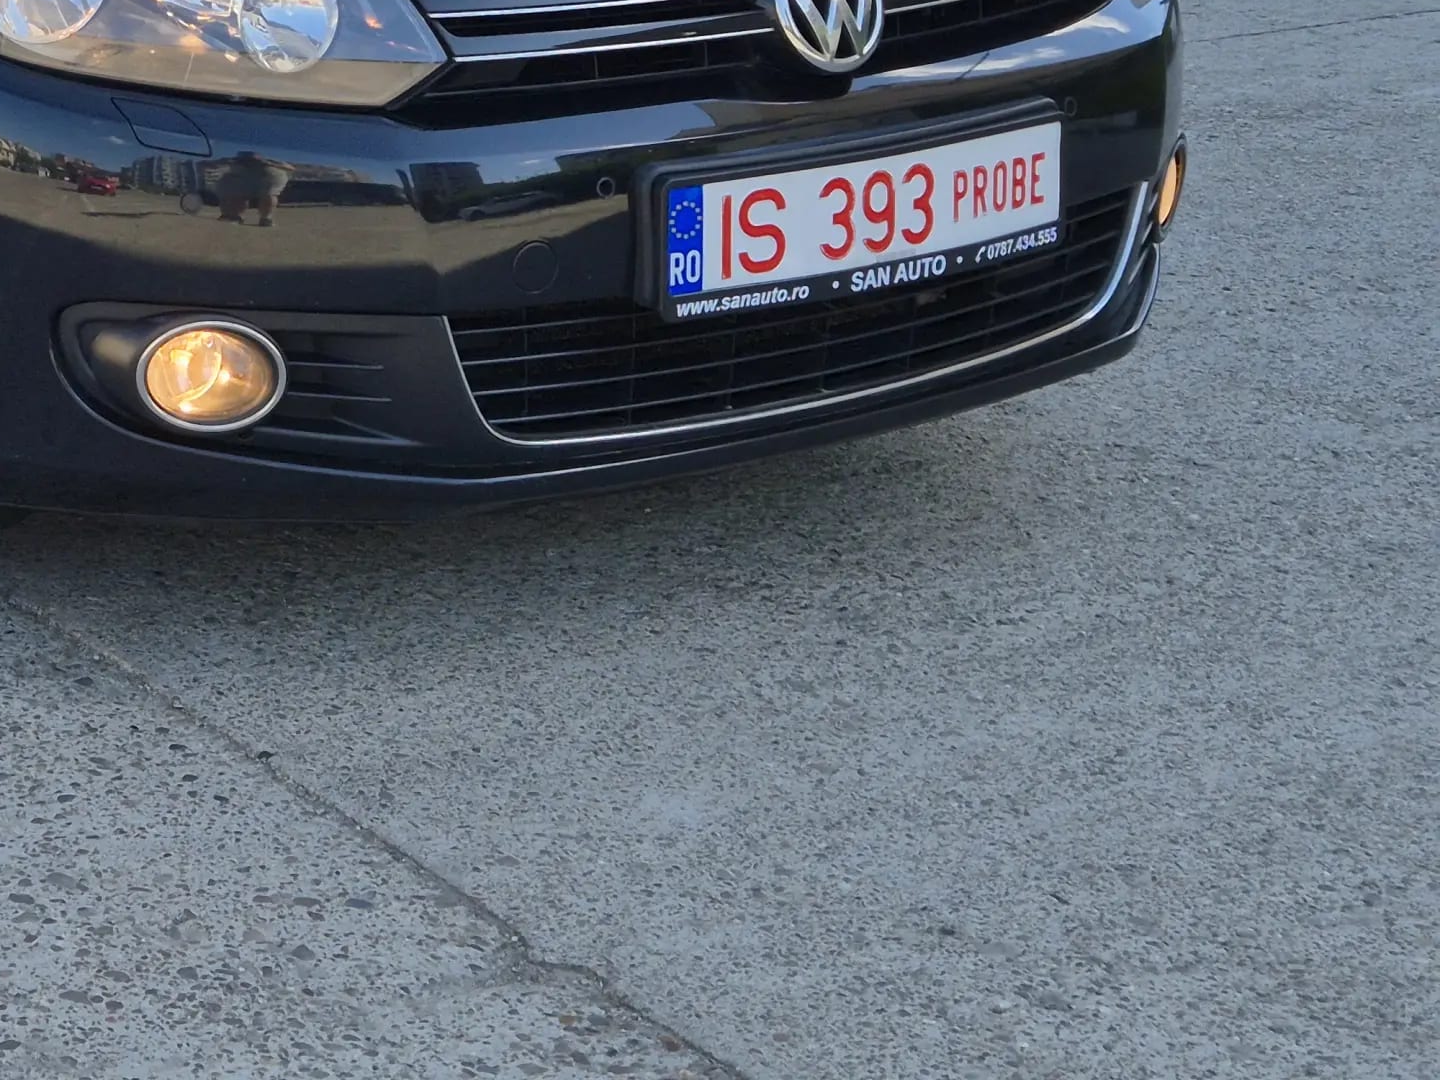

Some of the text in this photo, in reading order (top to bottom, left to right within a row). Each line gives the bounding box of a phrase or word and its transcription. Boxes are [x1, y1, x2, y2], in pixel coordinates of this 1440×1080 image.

[721, 151, 1047, 280] IS 393 PROBE
[669, 249, 702, 287] RO
[676, 226, 1058, 318] www.sanauto.ro SAN AUTO 0787.434.555
